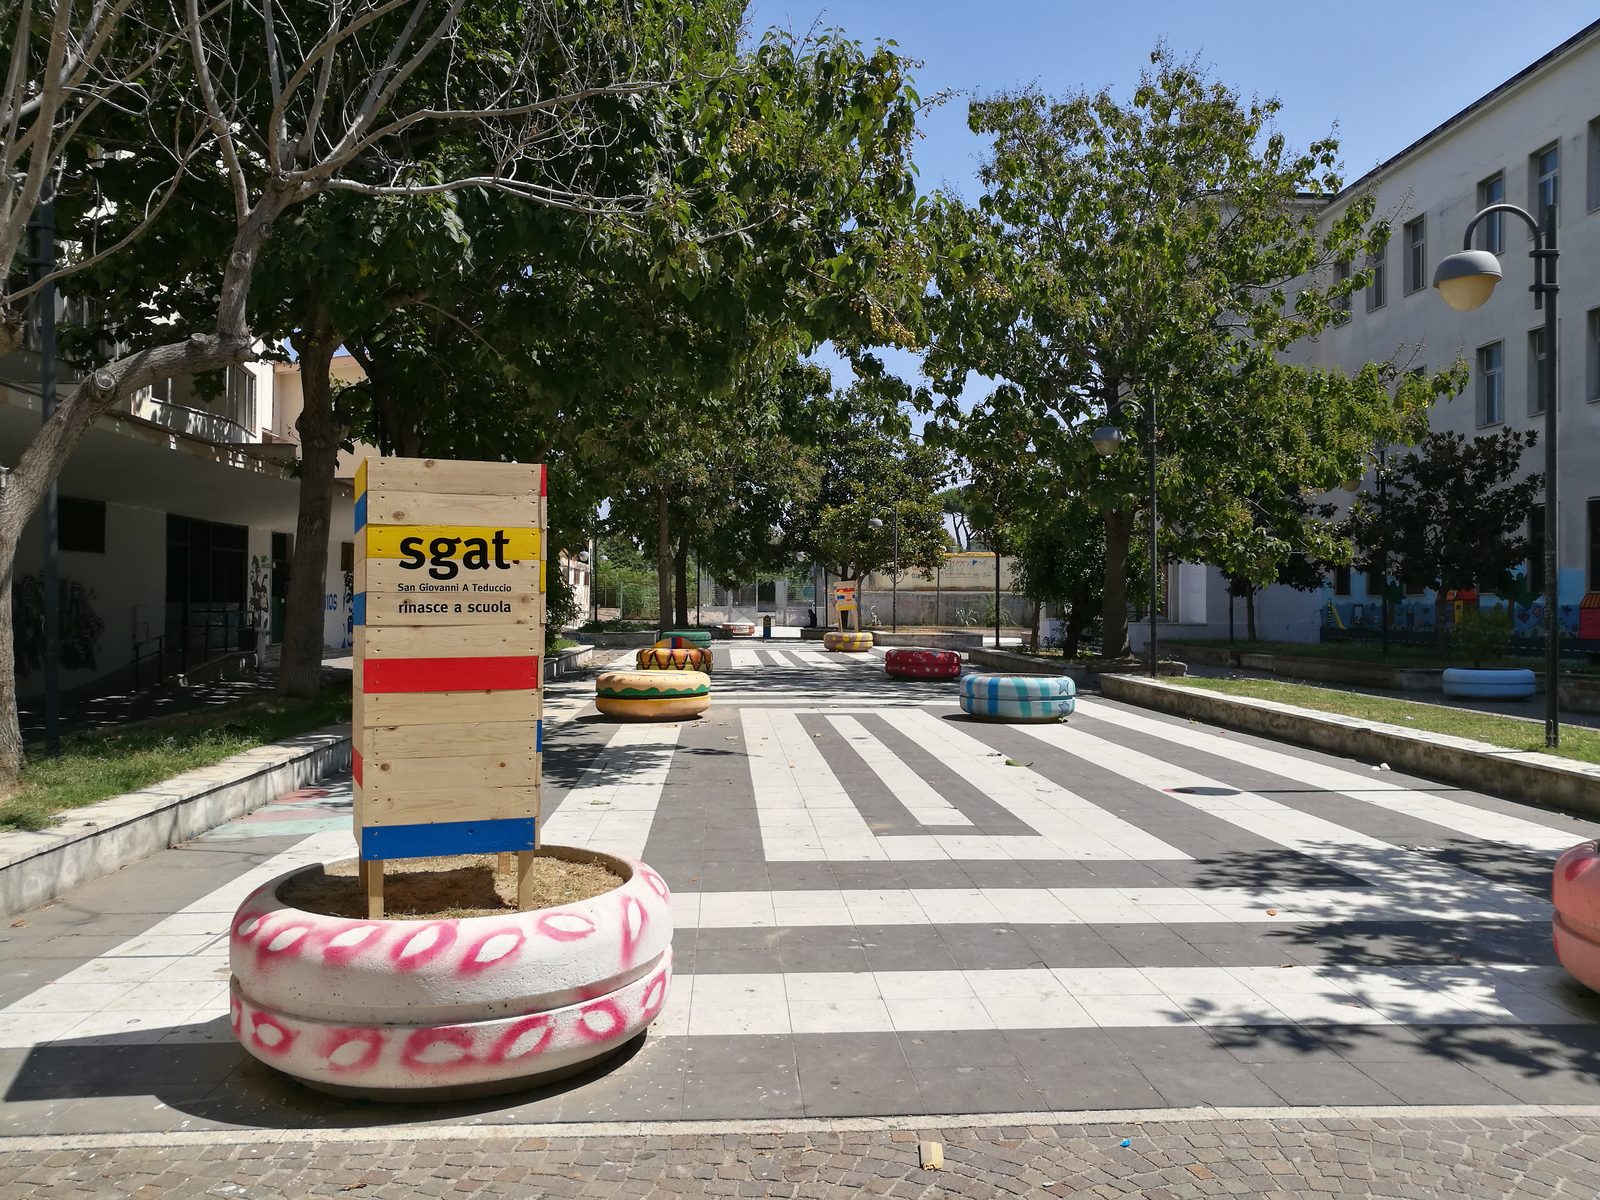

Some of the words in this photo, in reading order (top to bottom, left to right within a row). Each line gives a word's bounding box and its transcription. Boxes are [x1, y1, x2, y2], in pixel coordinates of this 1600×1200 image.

[397, 583, 416, 592] San
[419, 583, 459, 592] Giovanni
[462, 583, 469, 592] A
[472, 583, 512, 592] Teduccio
[398, 601, 449, 614] rinasce
[454, 603, 462, 613] a
[467, 600, 511, 613] scuola
